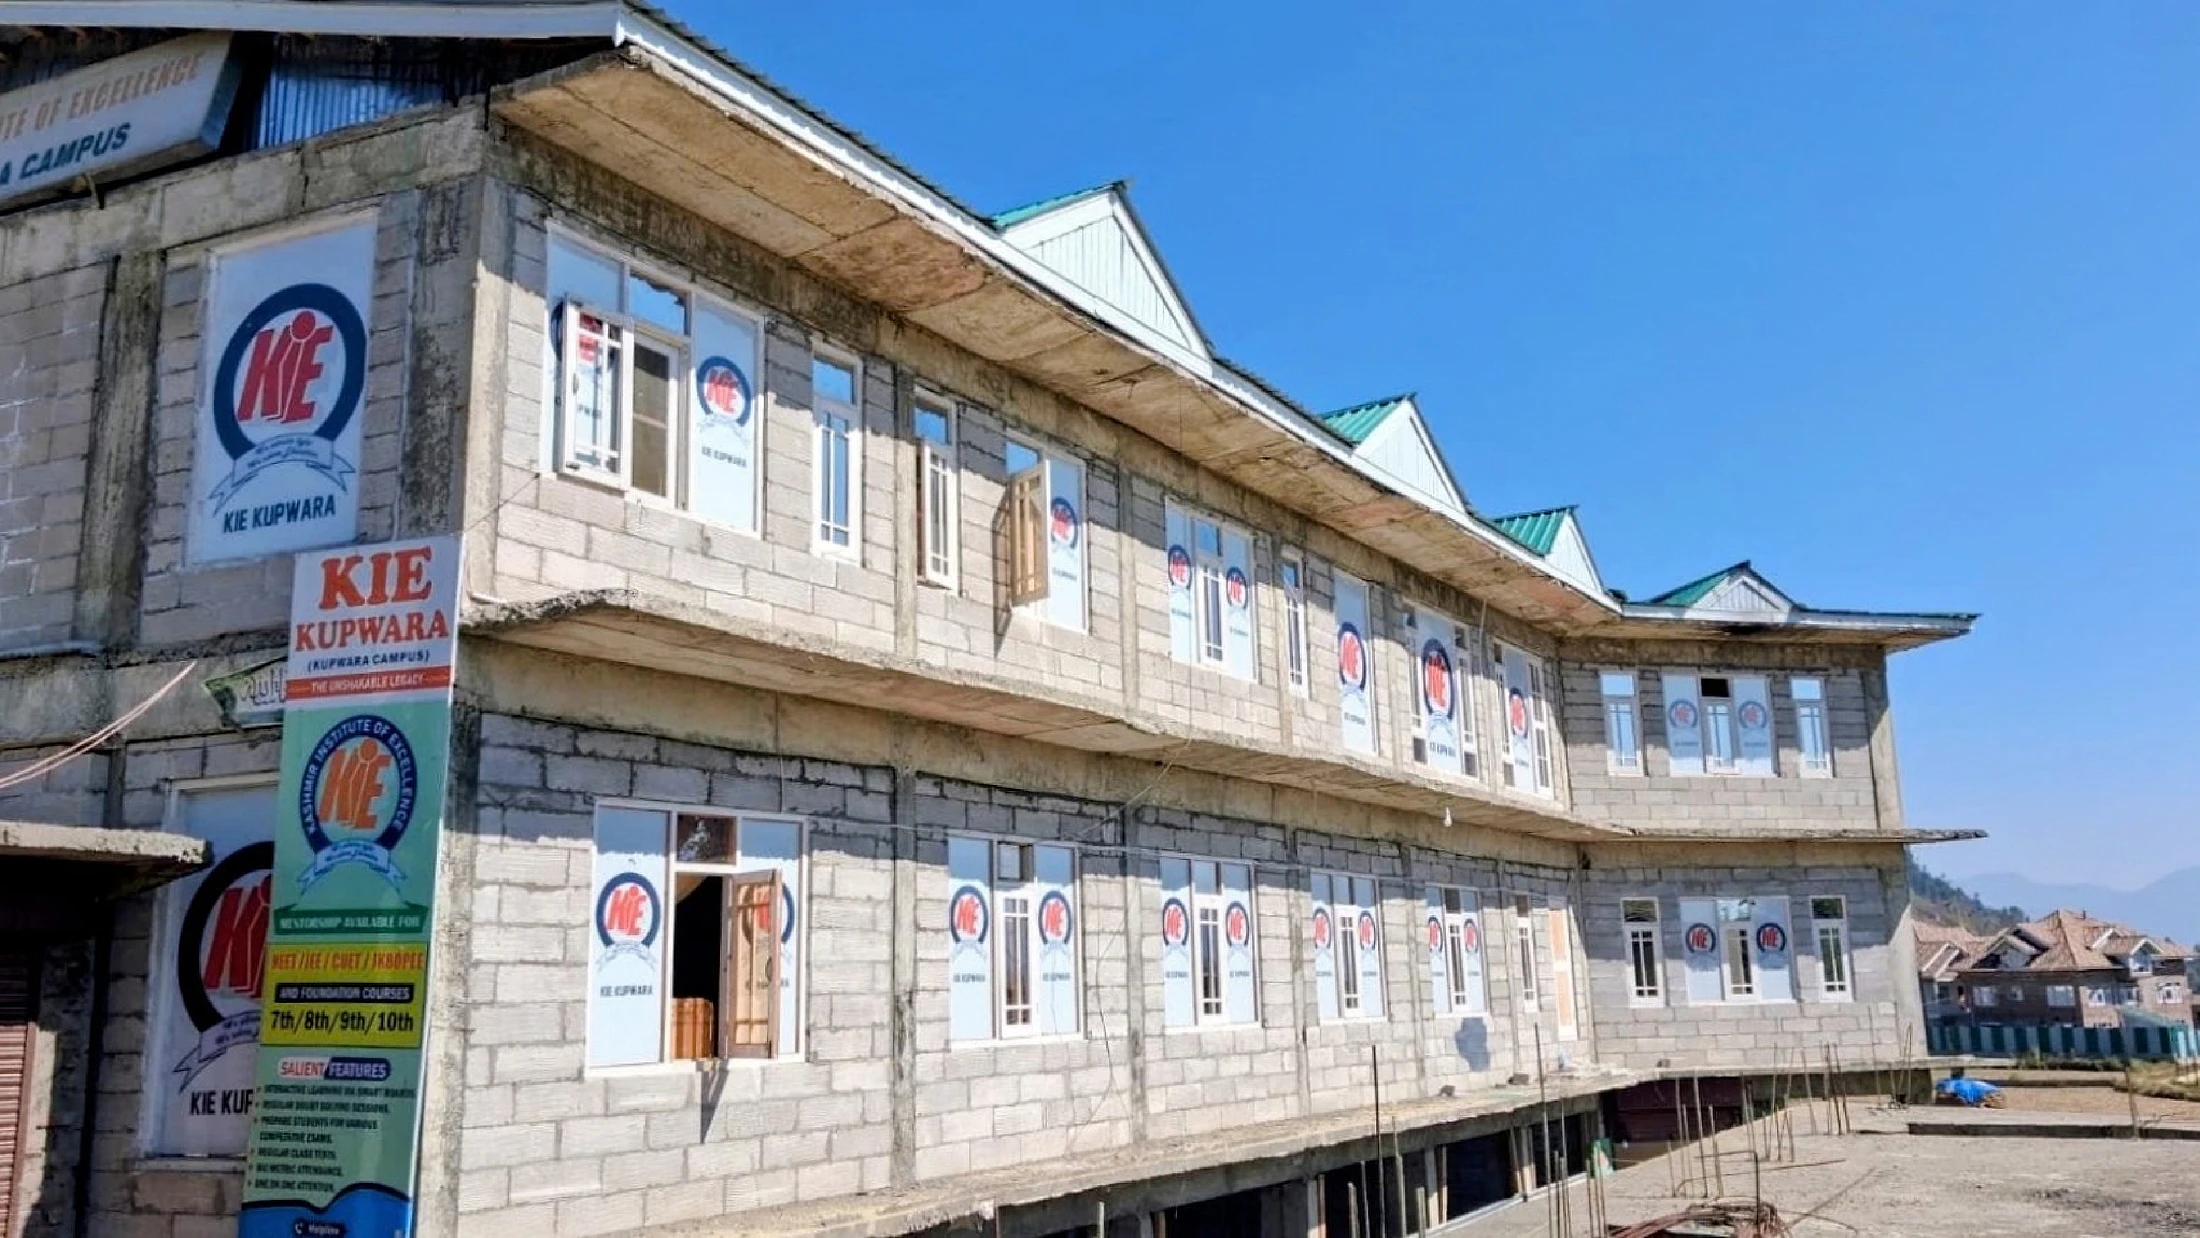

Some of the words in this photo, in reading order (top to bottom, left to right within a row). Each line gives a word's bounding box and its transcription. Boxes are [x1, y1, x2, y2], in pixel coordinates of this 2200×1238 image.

[34, 95, 62, 131] OF
[67, 54, 200, 119] EXCELLENCE
[19, 122, 131, 180] CAMPUS
[223, 510, 248, 533] KIE
[252, 495, 336, 529] KUPWARA
[318, 545, 432, 611] KIE
[295, 608, 450, 652] KUPWARA
[307, 655, 369, 672] (KUPWARA
[372, 650, 430, 666] CAMPUS)
[311, 679, 328, 693] THE
[390, 674, 423, 688] LEGACY
[303, 766, 318, 833] KASHMIR
[315, 719, 370, 762] INSTITUTE
[373, 722, 391, 736] OF
[388, 734, 413, 830] EXCELLENCE
[344, 915, 395, 928] AVAILABLE
[399, 915, 420, 928] FOR
[279, 987, 299, 1000] AND
[300, 987, 360, 1000] FOUNDATION
[362, 987, 410, 1000] COURSES
[281, 1061, 325, 1076] SALIENT
[328, 1062, 387, 1078] FEATURES
[189, 1090, 215, 1116] KIE
